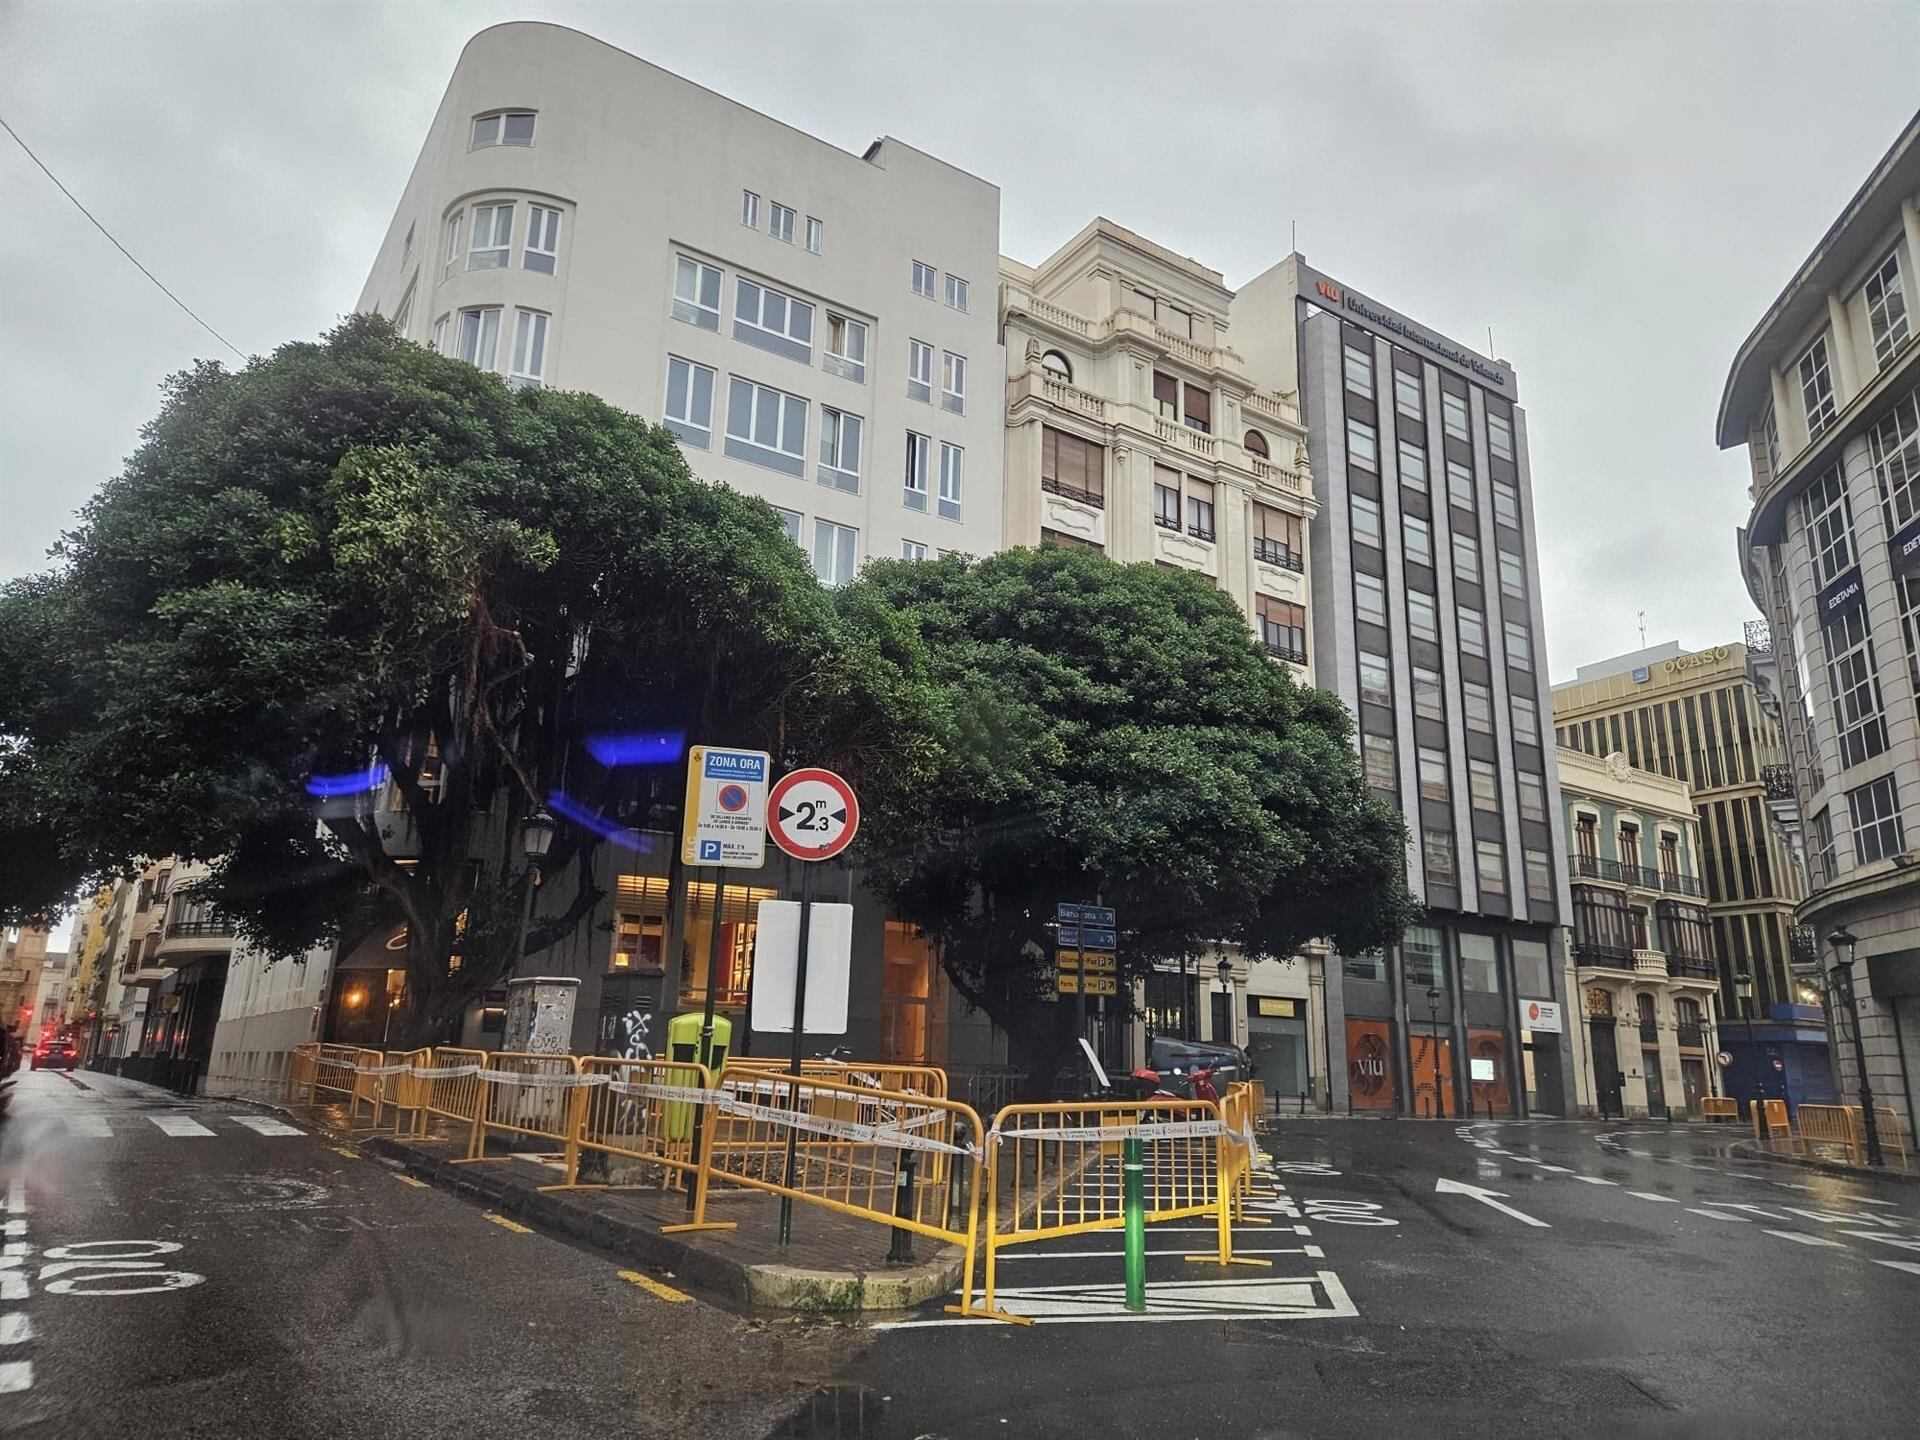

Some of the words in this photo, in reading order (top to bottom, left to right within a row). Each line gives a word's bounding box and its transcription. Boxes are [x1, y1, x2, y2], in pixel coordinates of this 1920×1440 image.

[1316, 280, 1340, 303] viu
[1347, 296, 1402, 336] Universidad
[1403, 325, 1459, 364] Internacional
[1828, 582, 1860, 610] EDETANIA
[1664, 647, 1729, 674] OCASO
[709, 755, 738, 768] ZONA
[740, 758, 761, 770] ORA
[1357, 1053, 1384, 1076] viu
